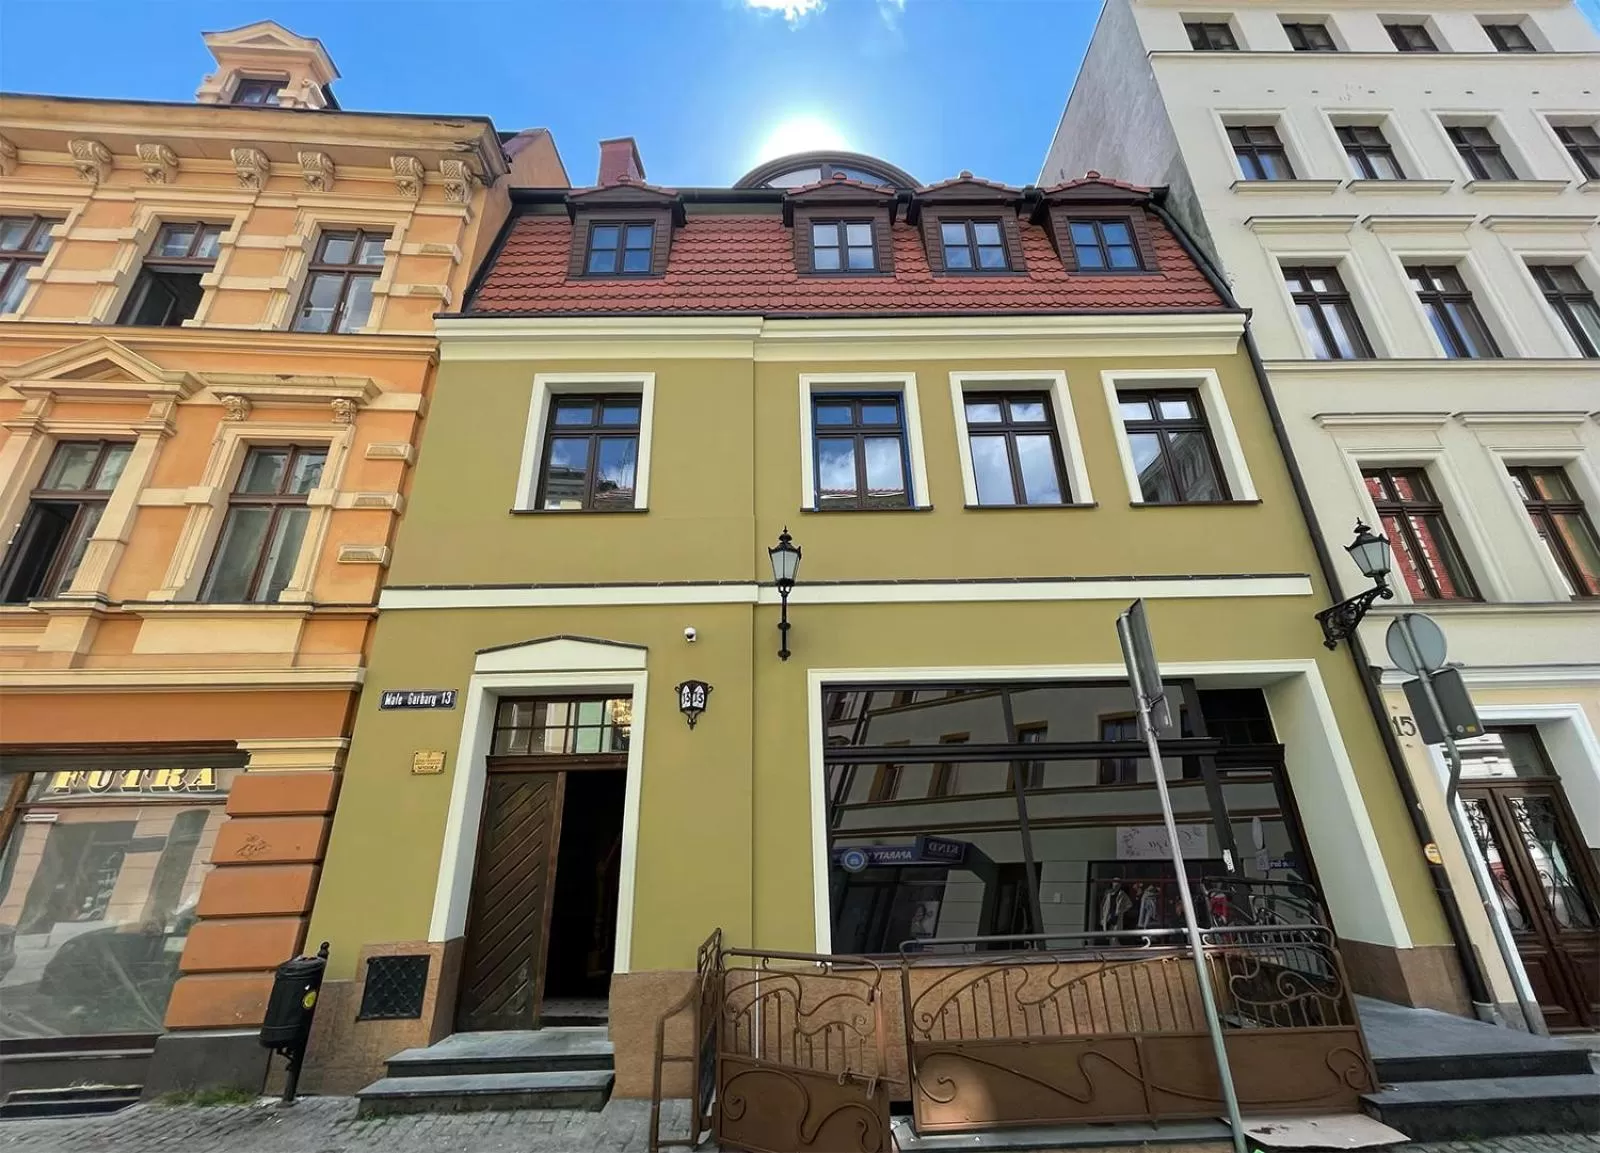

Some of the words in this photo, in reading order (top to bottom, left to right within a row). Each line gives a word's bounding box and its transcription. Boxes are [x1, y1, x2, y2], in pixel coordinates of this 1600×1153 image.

[407, 692, 437, 706] Garbary
[441, 691, 452, 704] 13
[1392, 716, 1416, 736] 15
[53, 768, 217, 793] FUTRA
